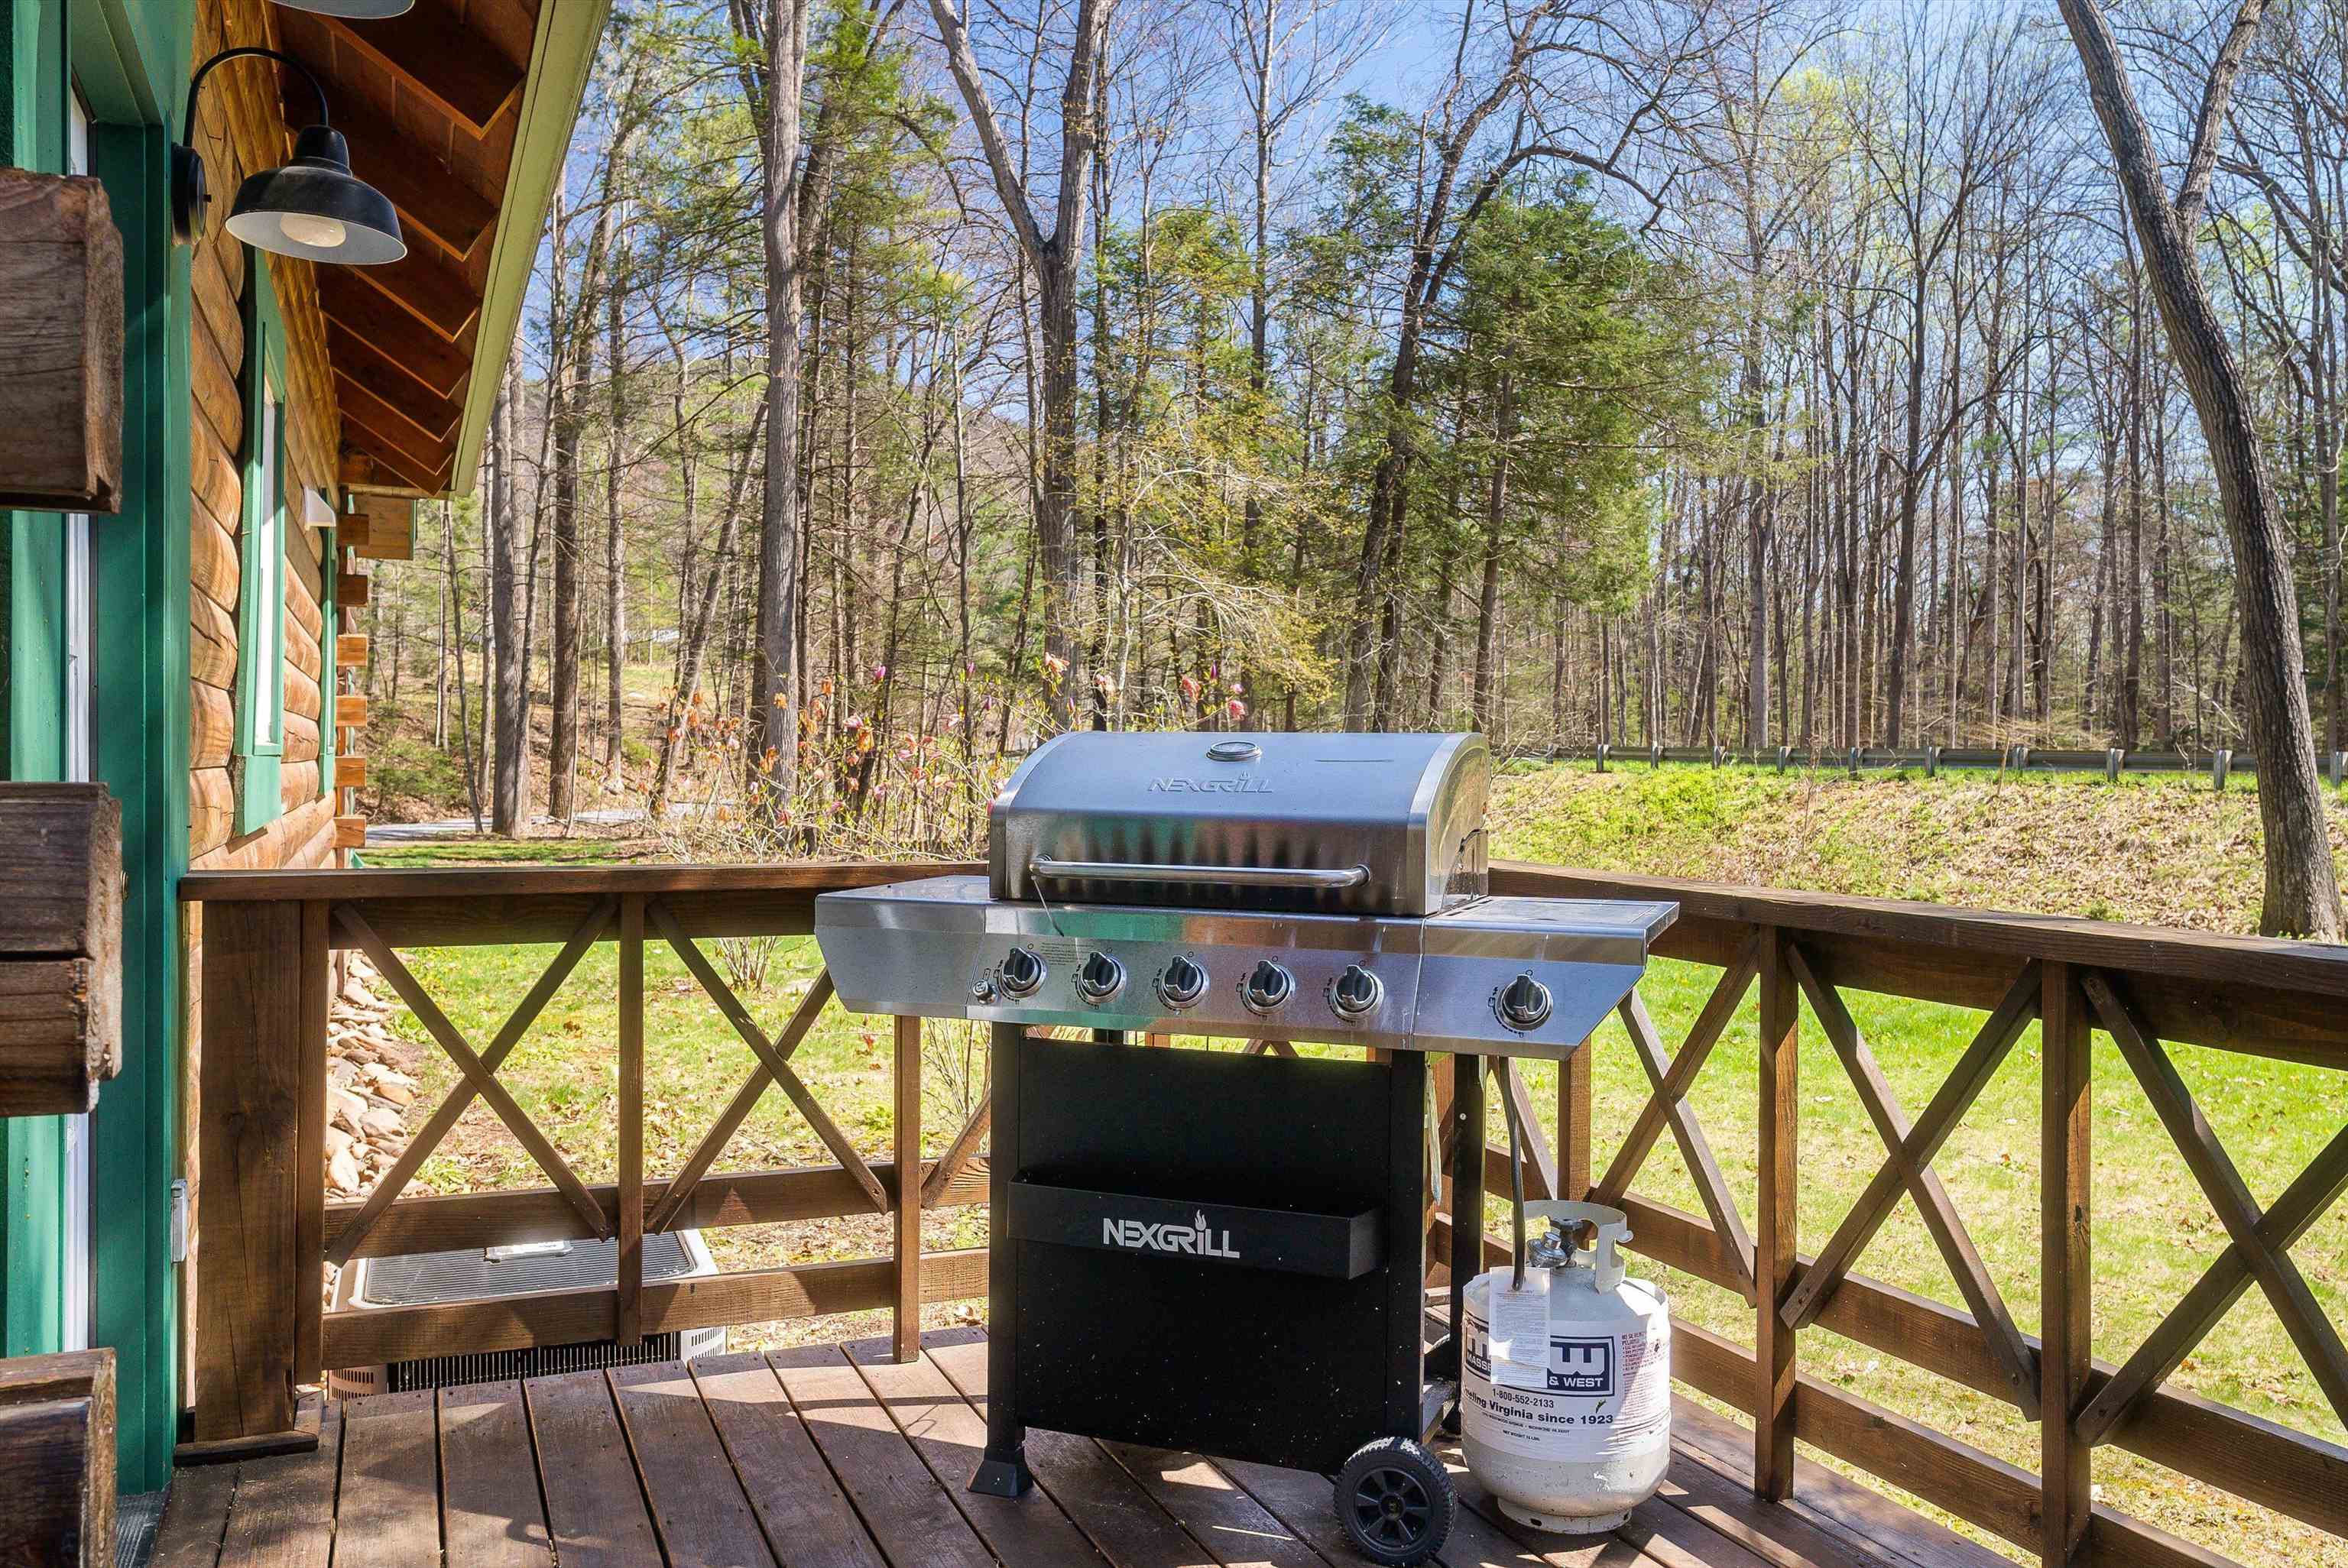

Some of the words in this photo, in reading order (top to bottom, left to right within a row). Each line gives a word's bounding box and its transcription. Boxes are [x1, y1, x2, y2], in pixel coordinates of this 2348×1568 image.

[1147, 771, 1272, 793] NEXGRILL
[1103, 1210, 1240, 1259] NEXGRILL
[1549, 1376, 1559, 1386] &
[1563, 1377, 1604, 1388] WEST
[1493, 1388, 1554, 1408] 1-800-552-2133
[1489, 1399, 1533, 1420] Virginia
[1538, 1413, 1575, 1424] since
[1581, 1414, 1613, 1424] 1923
